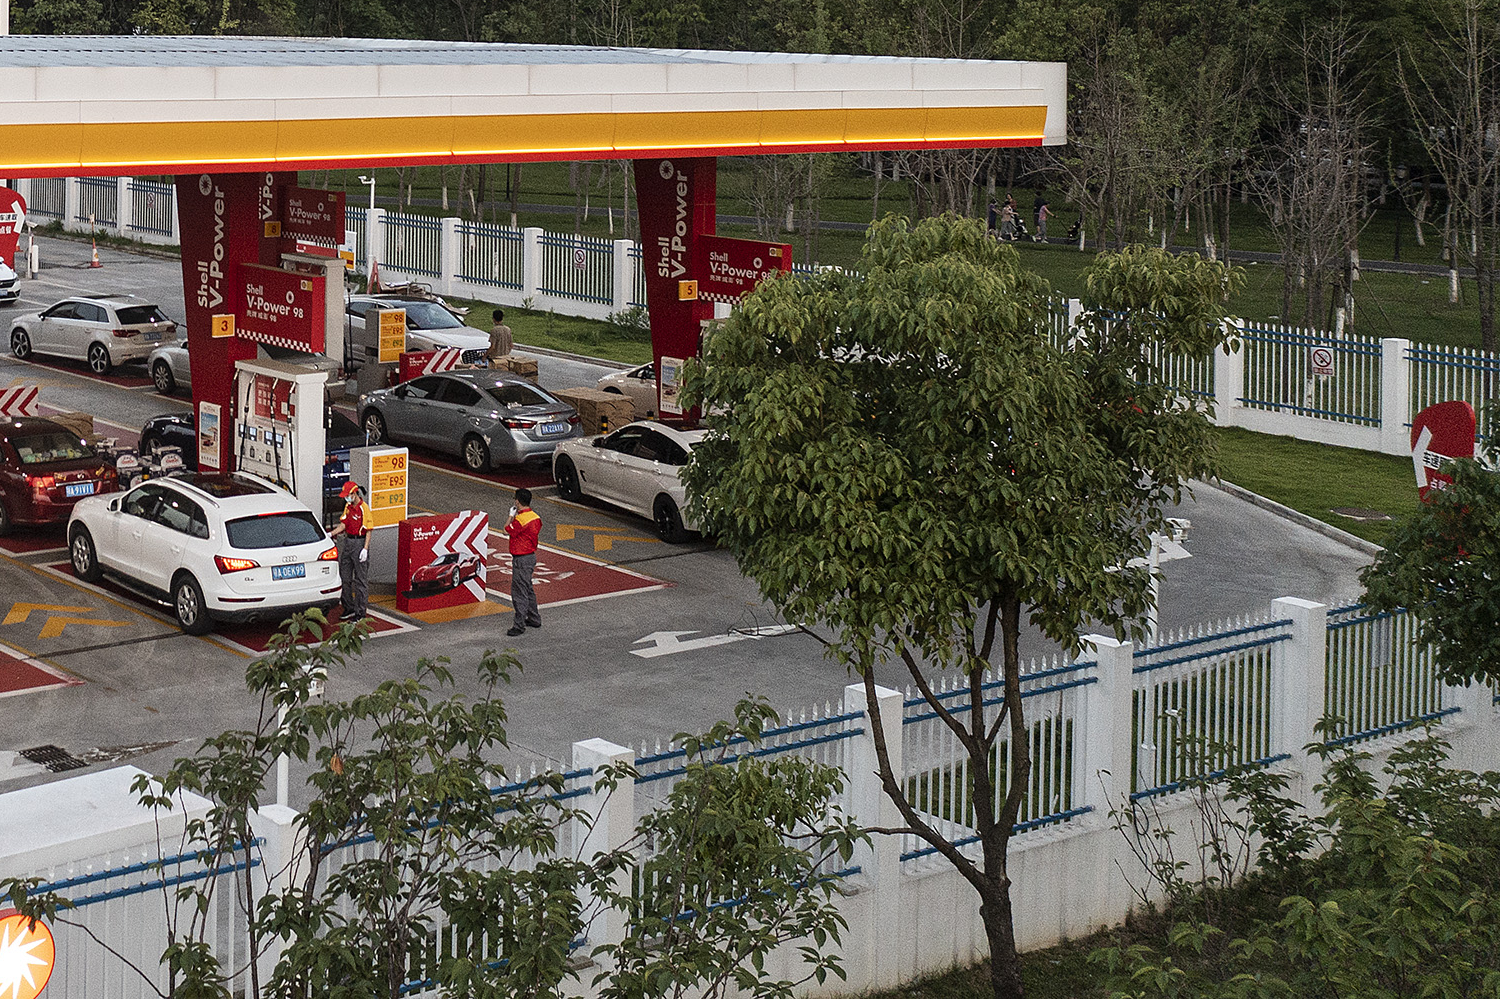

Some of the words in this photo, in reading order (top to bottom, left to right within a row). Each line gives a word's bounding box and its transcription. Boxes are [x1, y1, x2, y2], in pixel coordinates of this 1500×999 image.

[262, 172, 273, 220] V-Po
[289, 207, 321, 220] V-Power
[671, 171, 687, 278] V-Power
[209, 186, 225, 308] V-Power
[658, 236, 669, 277] Shell
[710, 252, 728, 262] Shell
[710, 262, 758, 279] V-Power
[197, 261, 208, 308] Shell
[246, 283, 263, 295] Shell
[687, 285, 693, 295] 5
[246, 295, 290, 316] V-Power
[293, 307, 304, 318] 98
[221, 320, 228, 331] 3
[392, 456, 404, 469] 98
[389, 475, 404, 487] E95
[389, 493, 404, 504] E92
